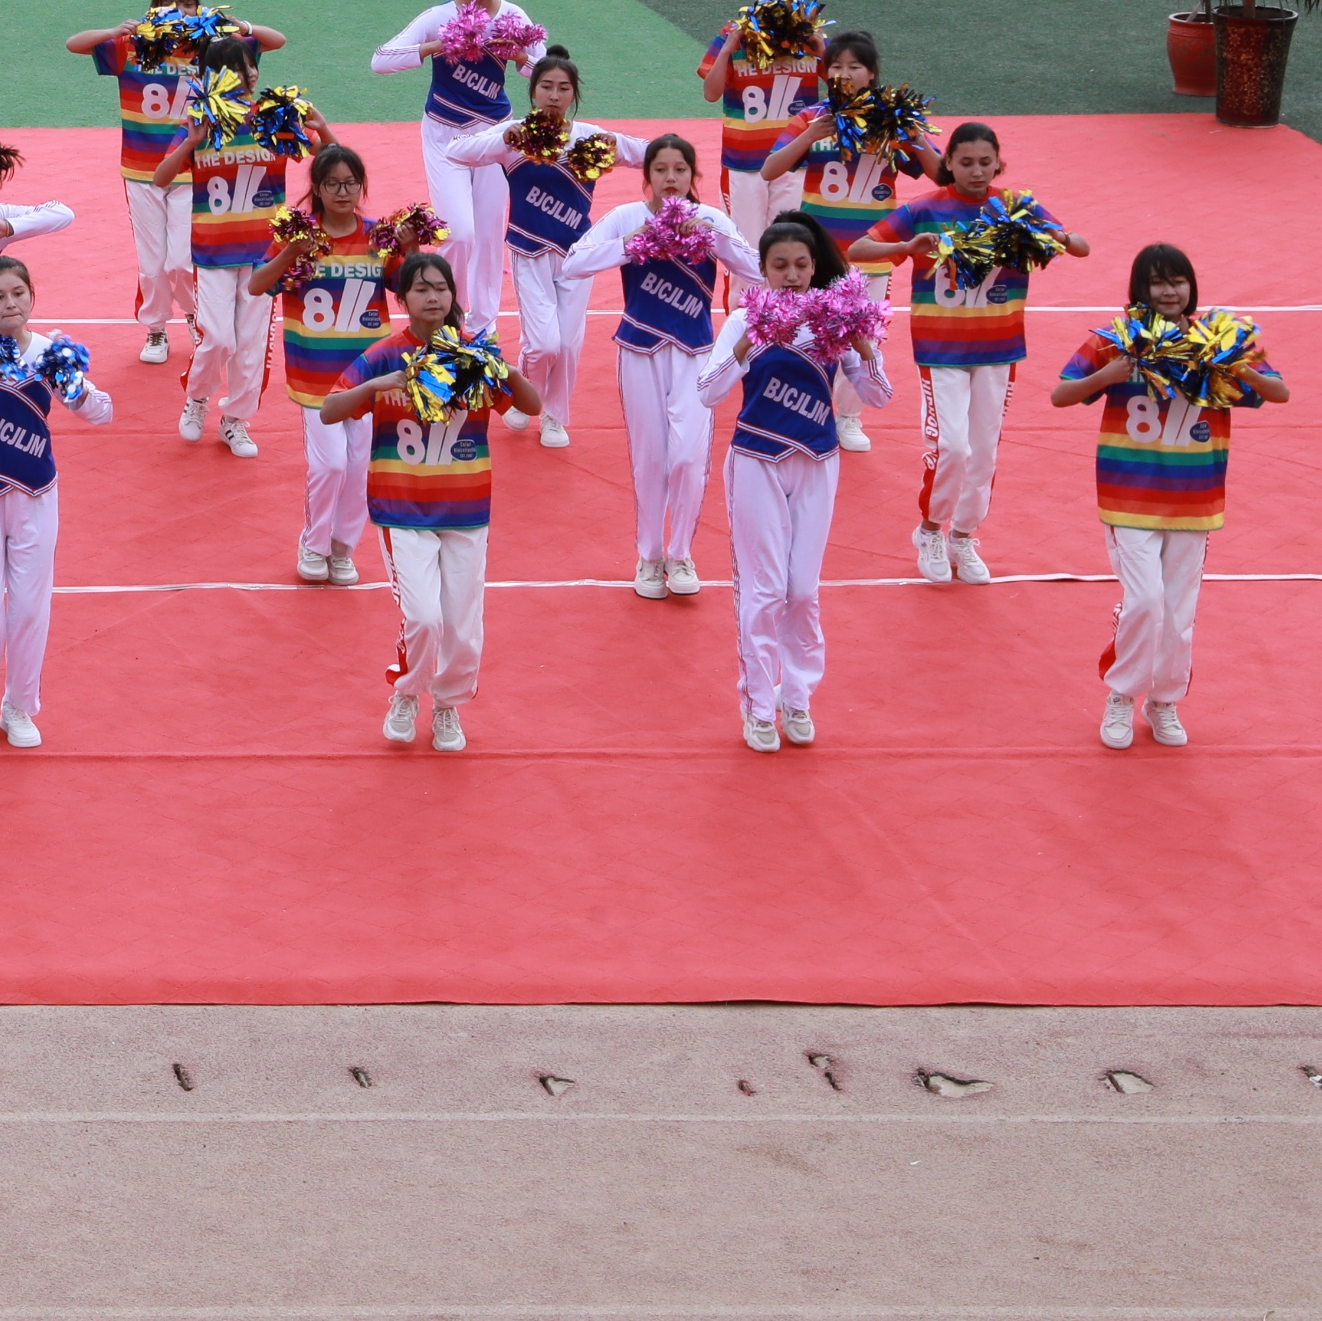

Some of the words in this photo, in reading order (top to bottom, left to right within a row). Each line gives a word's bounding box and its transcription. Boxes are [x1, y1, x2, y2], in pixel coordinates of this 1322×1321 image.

[525, 185, 582, 229] BJCJLJM
[331, 263, 383, 277] DESIG
[640, 271, 703, 318] BJCJLJM
[762, 376, 830, 426] BJCJLJM
